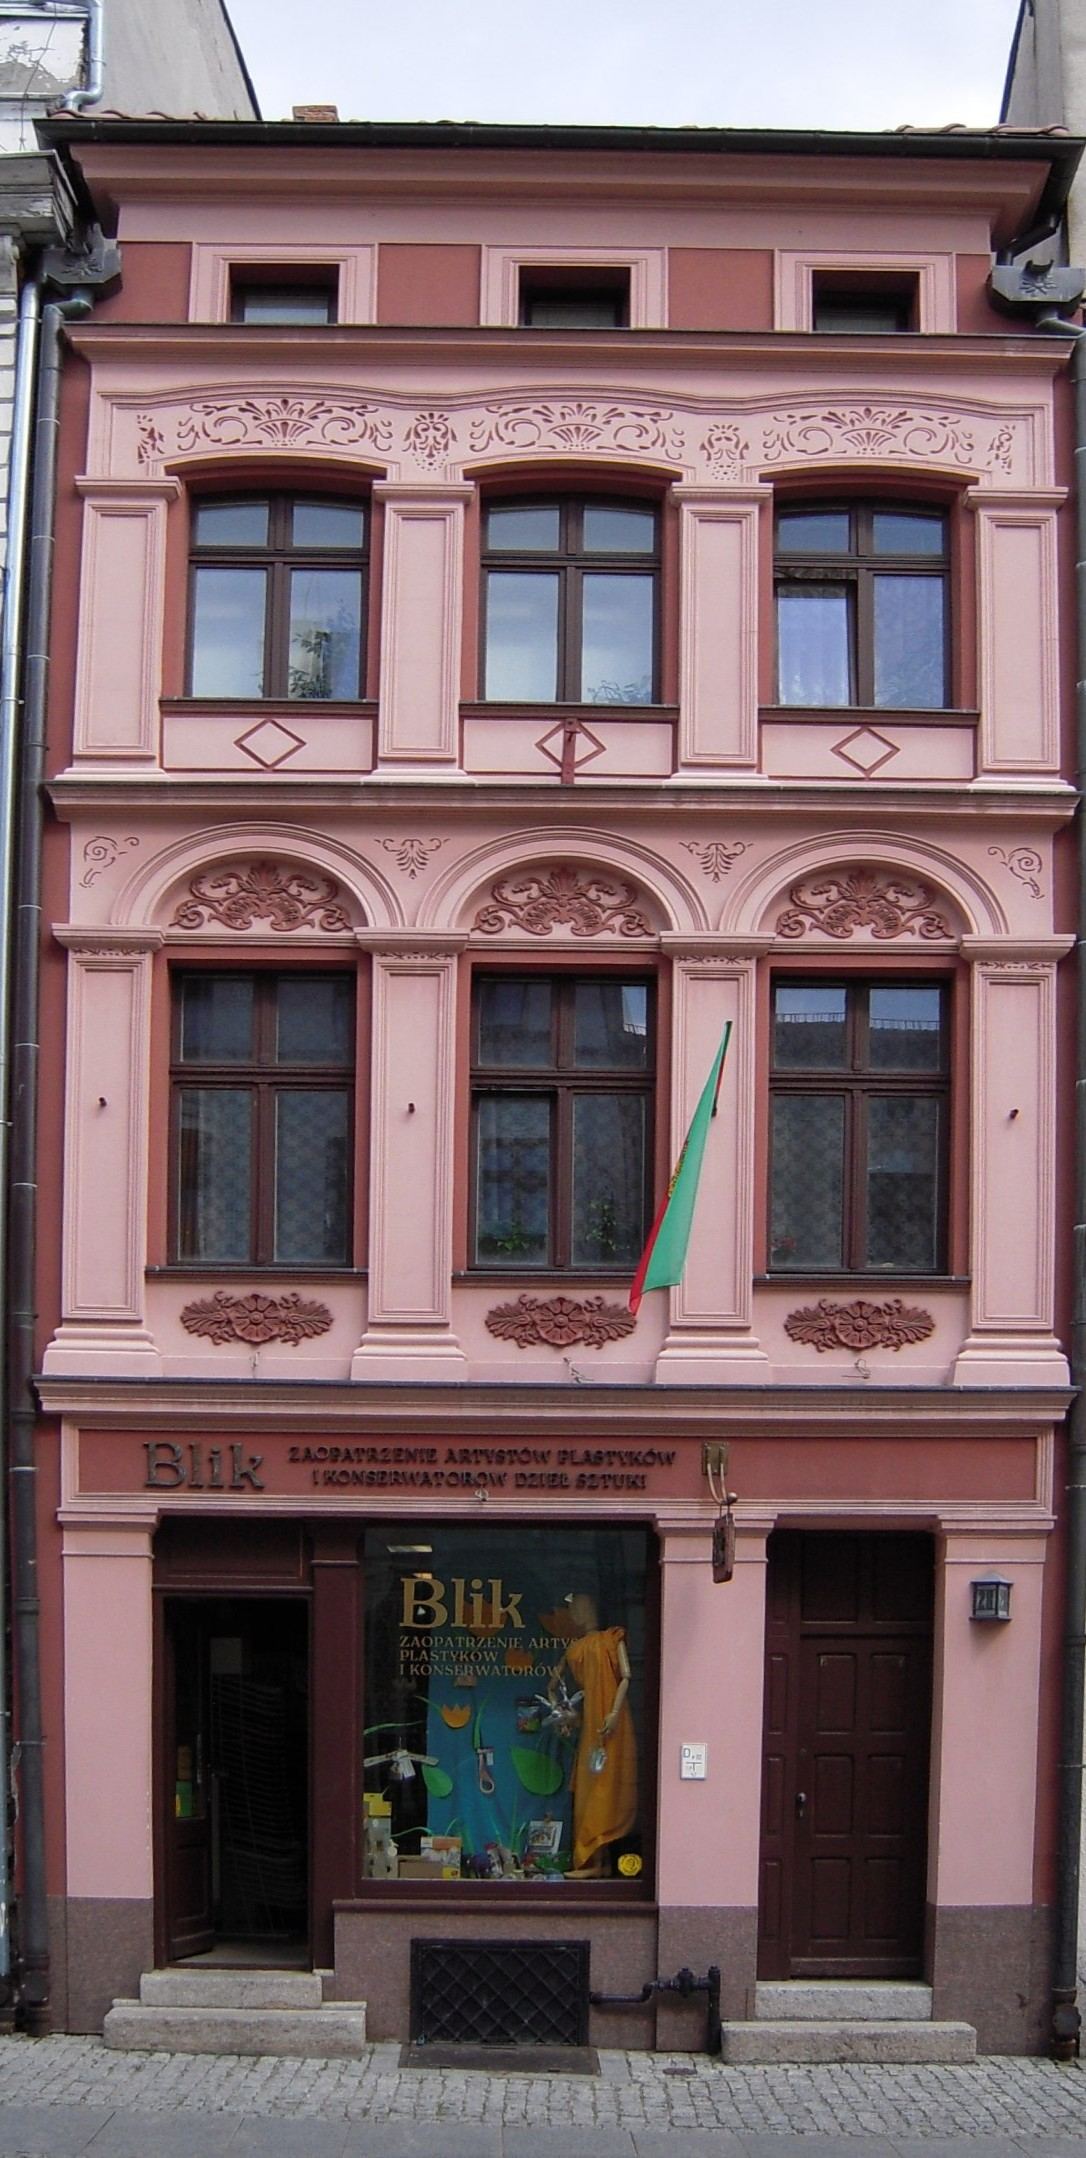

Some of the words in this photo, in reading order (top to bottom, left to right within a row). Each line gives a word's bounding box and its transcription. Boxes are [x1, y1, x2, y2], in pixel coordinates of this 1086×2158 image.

[143, 1441, 265, 1489] Blik
[288, 1446, 437, 1464] ZAOPATRZENIE
[444, 1447, 550, 1465] ARTYSTÓW
[557, 1447, 676, 1466] PLASTYKÓW
[514, 1471, 569, 1488] DZIEŁ
[575, 1472, 648, 1490] SZTUKI
[399, 1577, 526, 1629] Blik
[400, 1635, 523, 1648] ZAOPATRZENIE
[410, 1663, 562, 1677] KONSERWATORÓW
